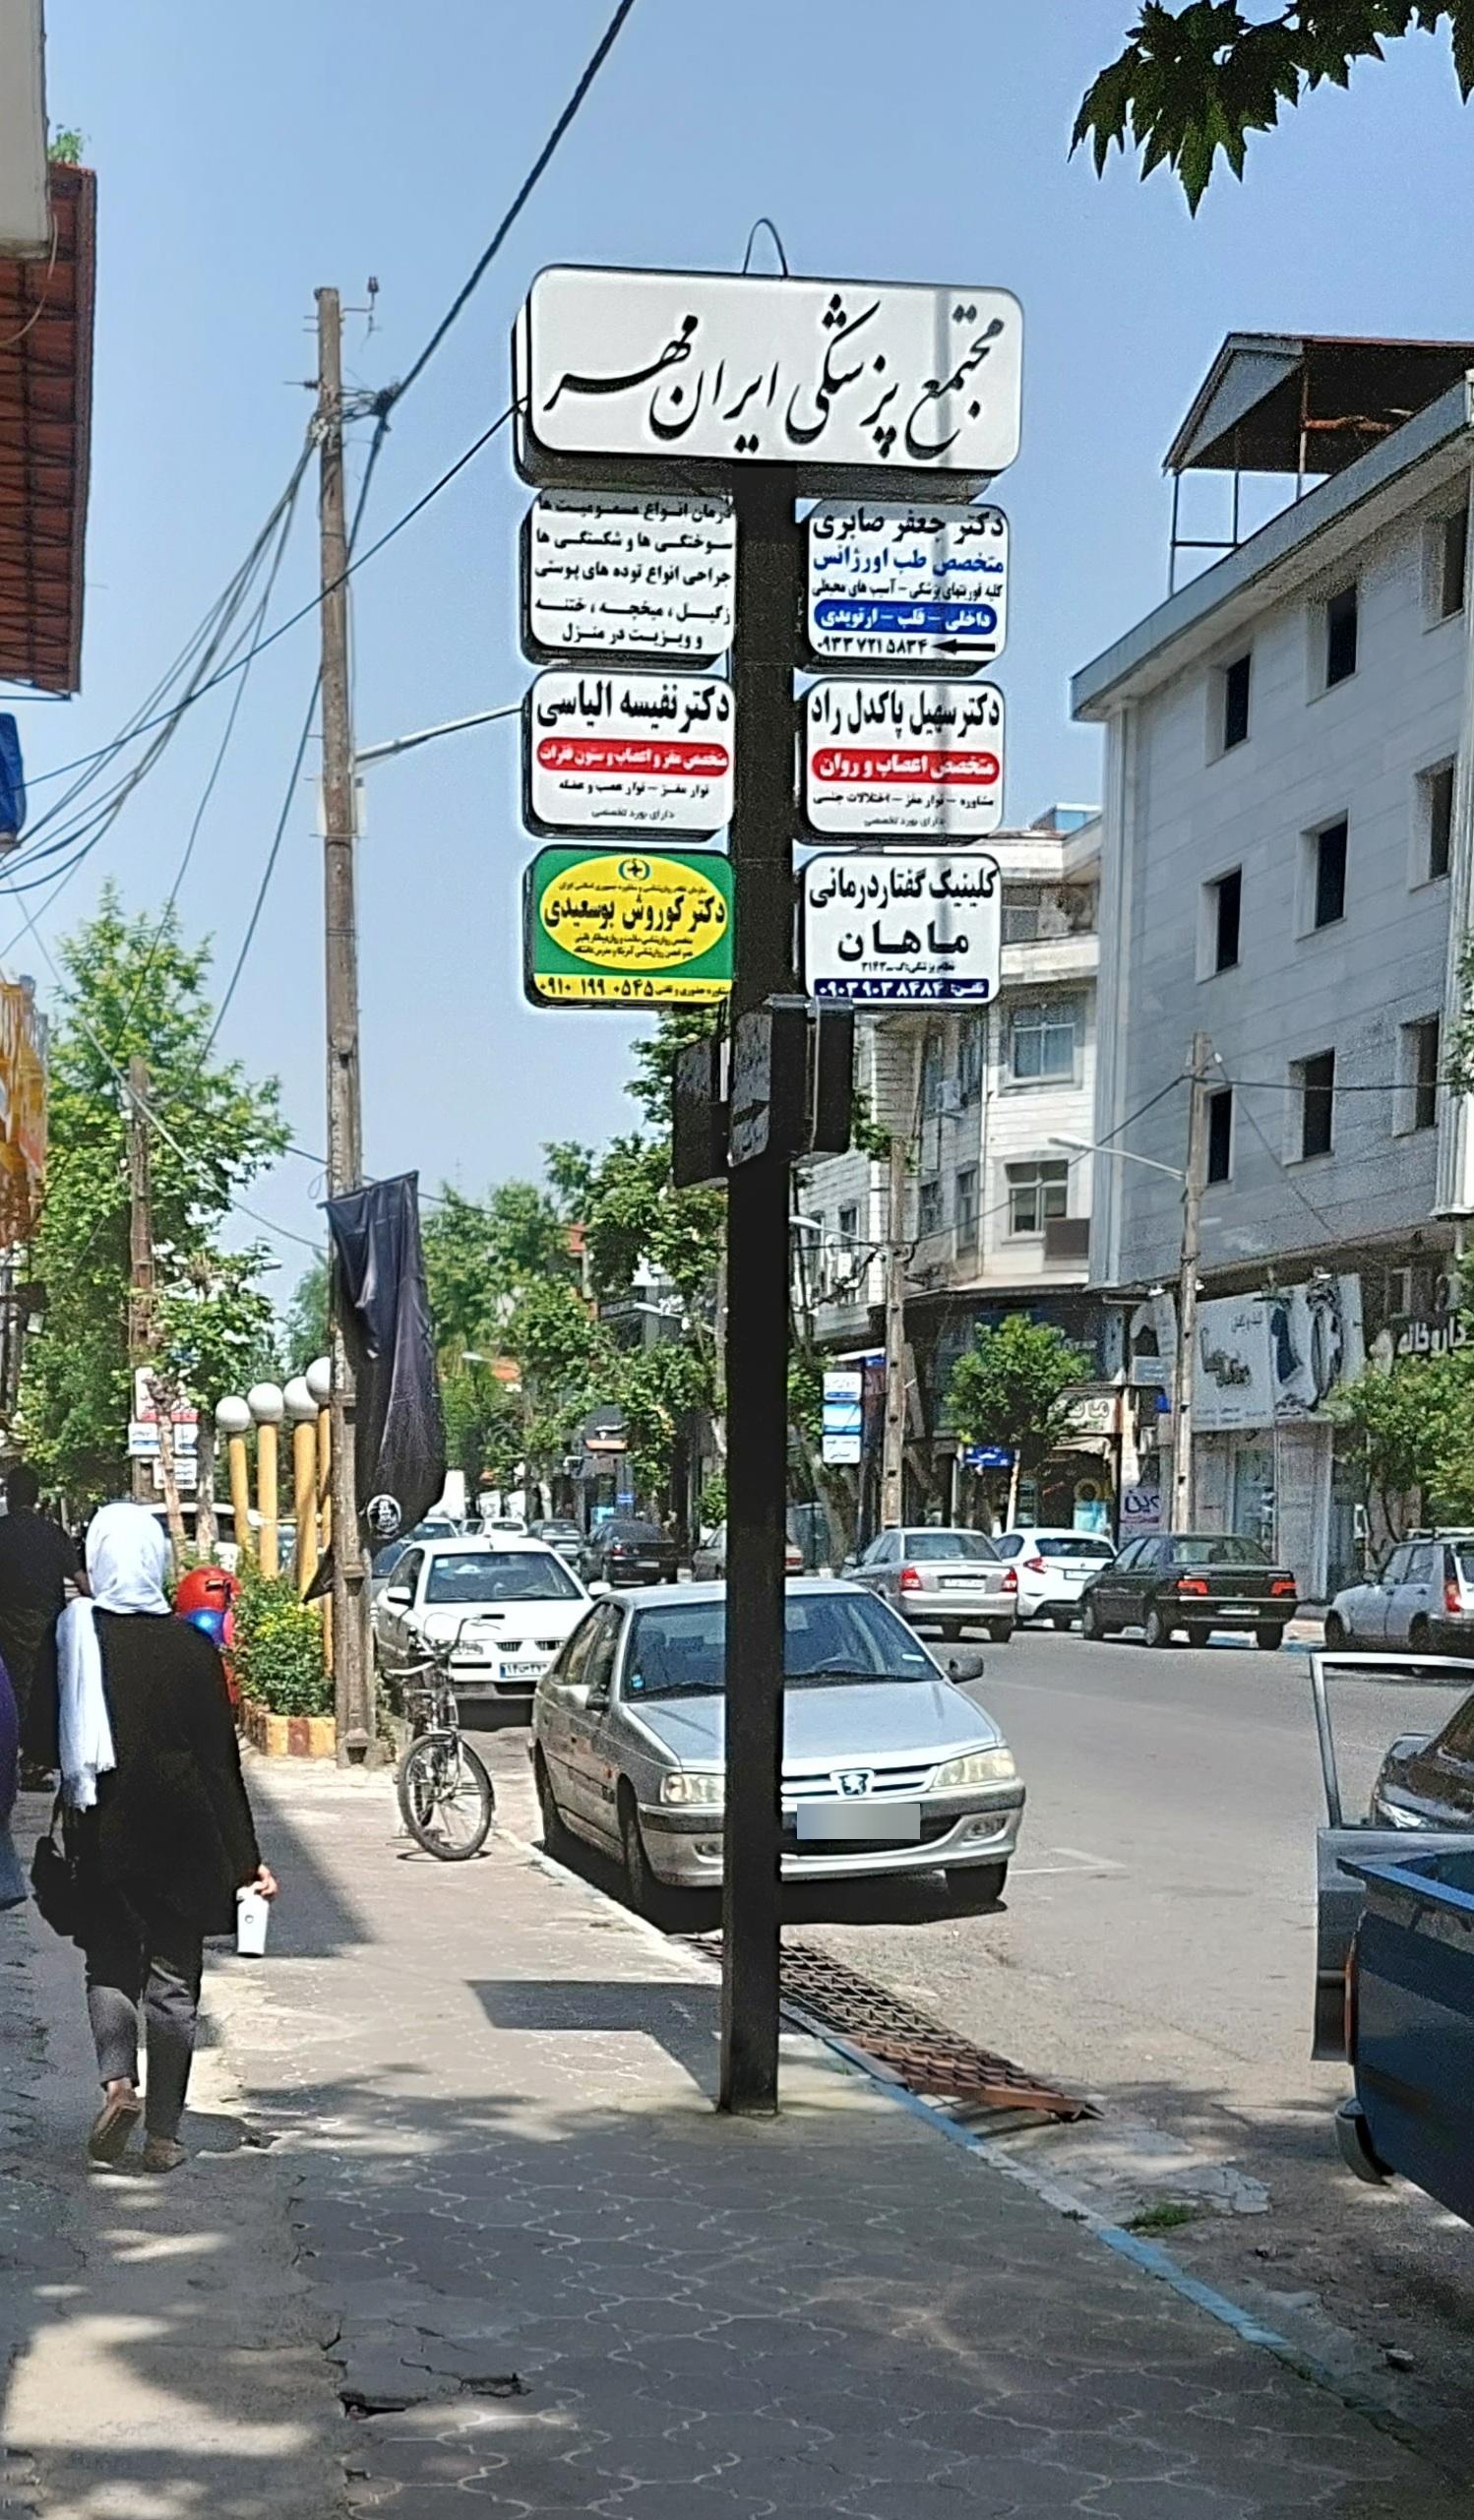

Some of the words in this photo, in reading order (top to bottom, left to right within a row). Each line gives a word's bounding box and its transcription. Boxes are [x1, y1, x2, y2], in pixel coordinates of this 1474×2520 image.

[543, 315, 699, 411] مهر
[785, 293, 900, 460] پزشکی
[903, 303, 1005, 461] مجتمع
[649, 359, 778, 455] ایران
[539, 498, 552, 512] ها
[644, 502, 688, 522] انواع
[692, 501, 732, 523] درمان
[813, 508, 884, 540] صابری
[892, 510, 946, 543] جعفر
[954, 512, 1004, 544] دکتر
[537, 529, 550, 543] ها
[554, 531, 622, 549] شکستگی
[627, 537, 634, 551] و
[638, 531, 650, 547] ها
[655, 533, 732, 554] سوختگی
[814, 544, 889, 573] اورژانس
[893, 549, 926, 574] طب
[933, 553, 1004, 576] متخصص
[535, 560, 579, 580] پوستی
[583, 561, 608, 580] های
[614, 564, 642, 583] توده
[645, 567, 679, 584] انواع
[683, 569, 731, 586] جراحی
[813, 580, 845, 596] محیطی
[849, 581, 866, 597] های
[870, 579, 894, 597] آسیب
[910, 582, 940, 600] پزشکی
[985, 584, 1003, 599] کلیه
[535, 597, 585, 613] ختنه
[821, 605, 877, 628] ارتوپدی
[897, 607, 925, 627] قلب
[946, 609, 991, 632] داخلی
[563, 624, 604, 642] منزل
[611, 628, 624, 645] در
[630, 629, 691, 647] ویزیت
[696, 635, 703, 649] و
[537, 680, 612, 727] الیاسی
[621, 684, 677, 729] نفیسه
[679, 686, 729, 733] دکتر
[811, 688, 840, 735] راد
[910, 690, 955, 735] سهیل
[848, 688, 903, 738] پاکدل
[957, 693, 1000, 738] دکتر
[540, 744, 574, 766] فقرات
[575, 748, 603, 767] ستون
[607, 753, 614, 766] و
[615, 749, 650, 764] اعصاب
[653, 757, 660, 768] و
[662, 753, 682, 769] مغز
[683, 754, 727, 770] متخصص
[819, 754, 861, 777] روان
[863, 763, 873, 778] و
[877, 755, 927, 778] اعصاب
[931, 757, 994, 778] متخصص
[559, 779, 583, 790] عضله
[587, 785, 592, 794] و
[596, 782, 622, 793] عصب
[626, 782, 645, 796] نوار
[661, 783, 686, 797] مغز
[690, 784, 709, 798] نوار
[813, 791, 843, 804] جنسی
[847, 791, 891, 804] اختلالات
[905, 793, 922, 808] مغز
[925, 793, 945, 809] نوار
[960, 794, 994, 809] مشاوره
[591, 809, 627, 819] تخصصی
[629, 810, 648, 820] بورد
[651, 810, 675, 820] دارای
[864, 816, 898, 827] تخصصی
[810, 867, 878, 908] درمانی
[877, 868, 926, 908] گفتار
[930, 868, 999, 907] کلینیک
[544, 896, 614, 930] بوسعیدی
[623, 893, 684, 931] کوروش
[689, 895, 725, 933] دکتر
[837, 920, 969, 961] ماهان
